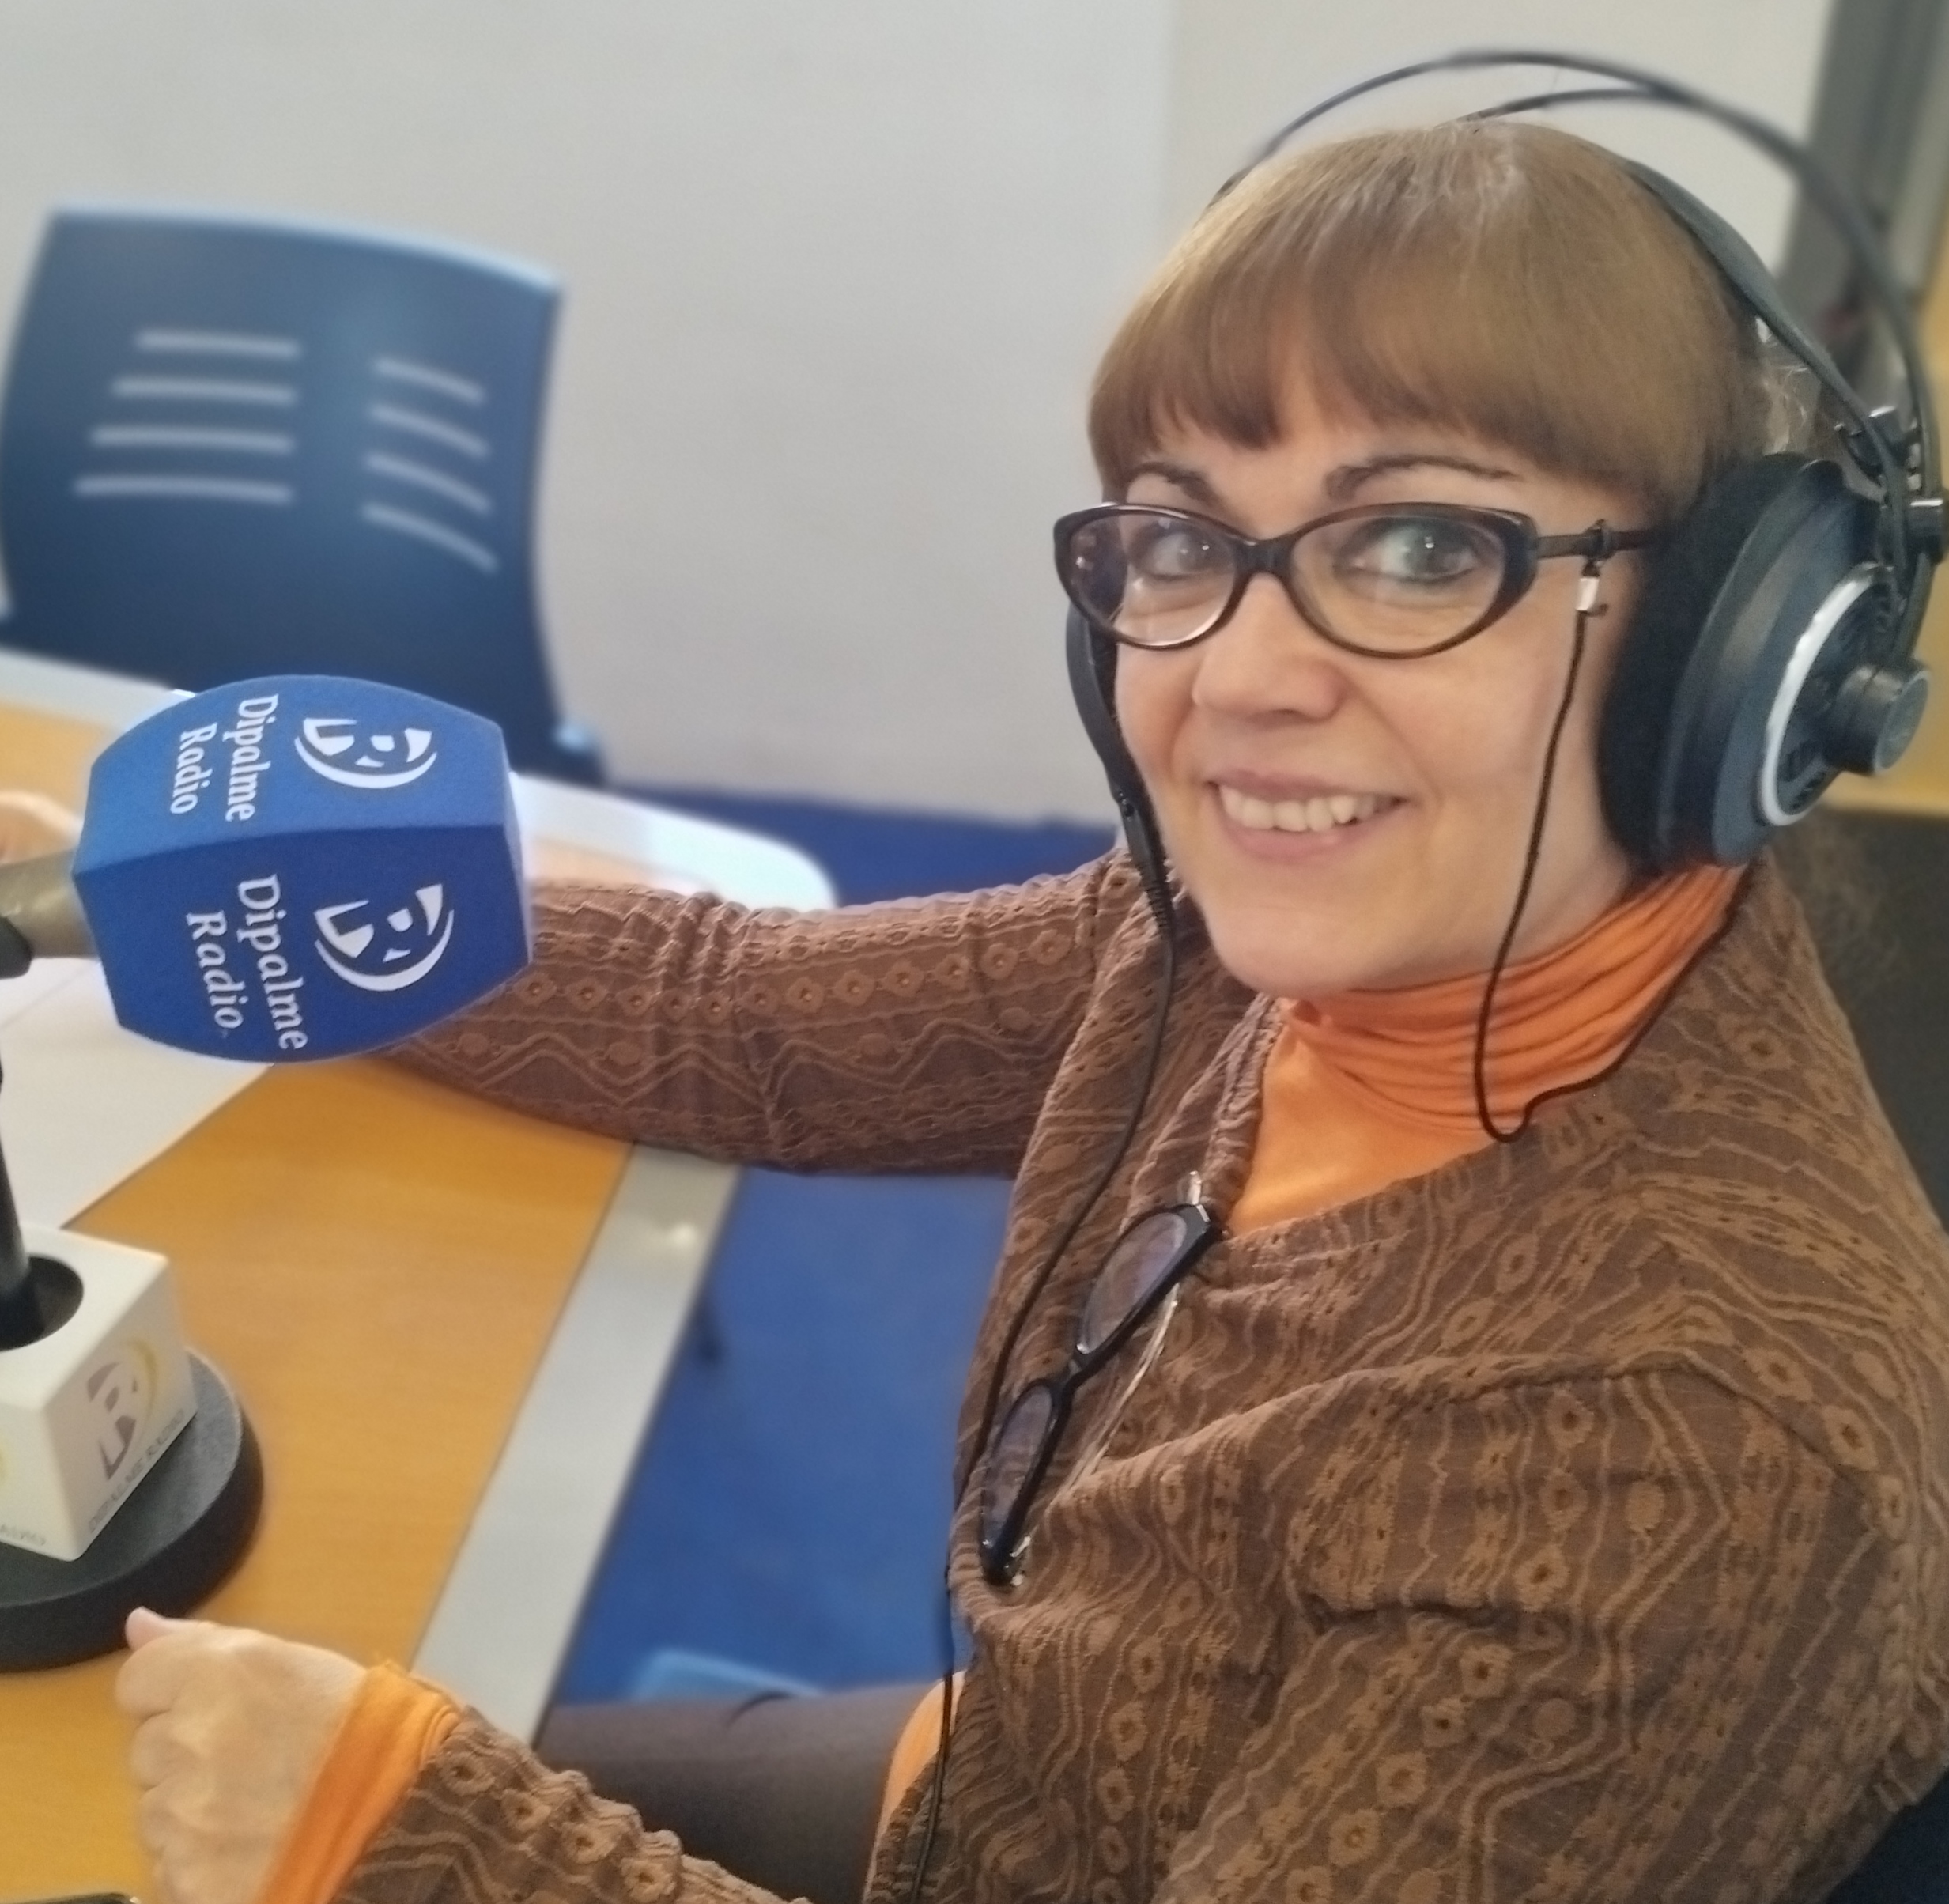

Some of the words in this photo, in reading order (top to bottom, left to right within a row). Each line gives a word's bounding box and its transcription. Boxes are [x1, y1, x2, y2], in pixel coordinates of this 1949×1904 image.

[170, 722, 217, 814] Radio
[222, 693, 279, 822] Dipalme
[186, 910, 249, 1029] Radio
[236, 874, 308, 1050] Dipalme
